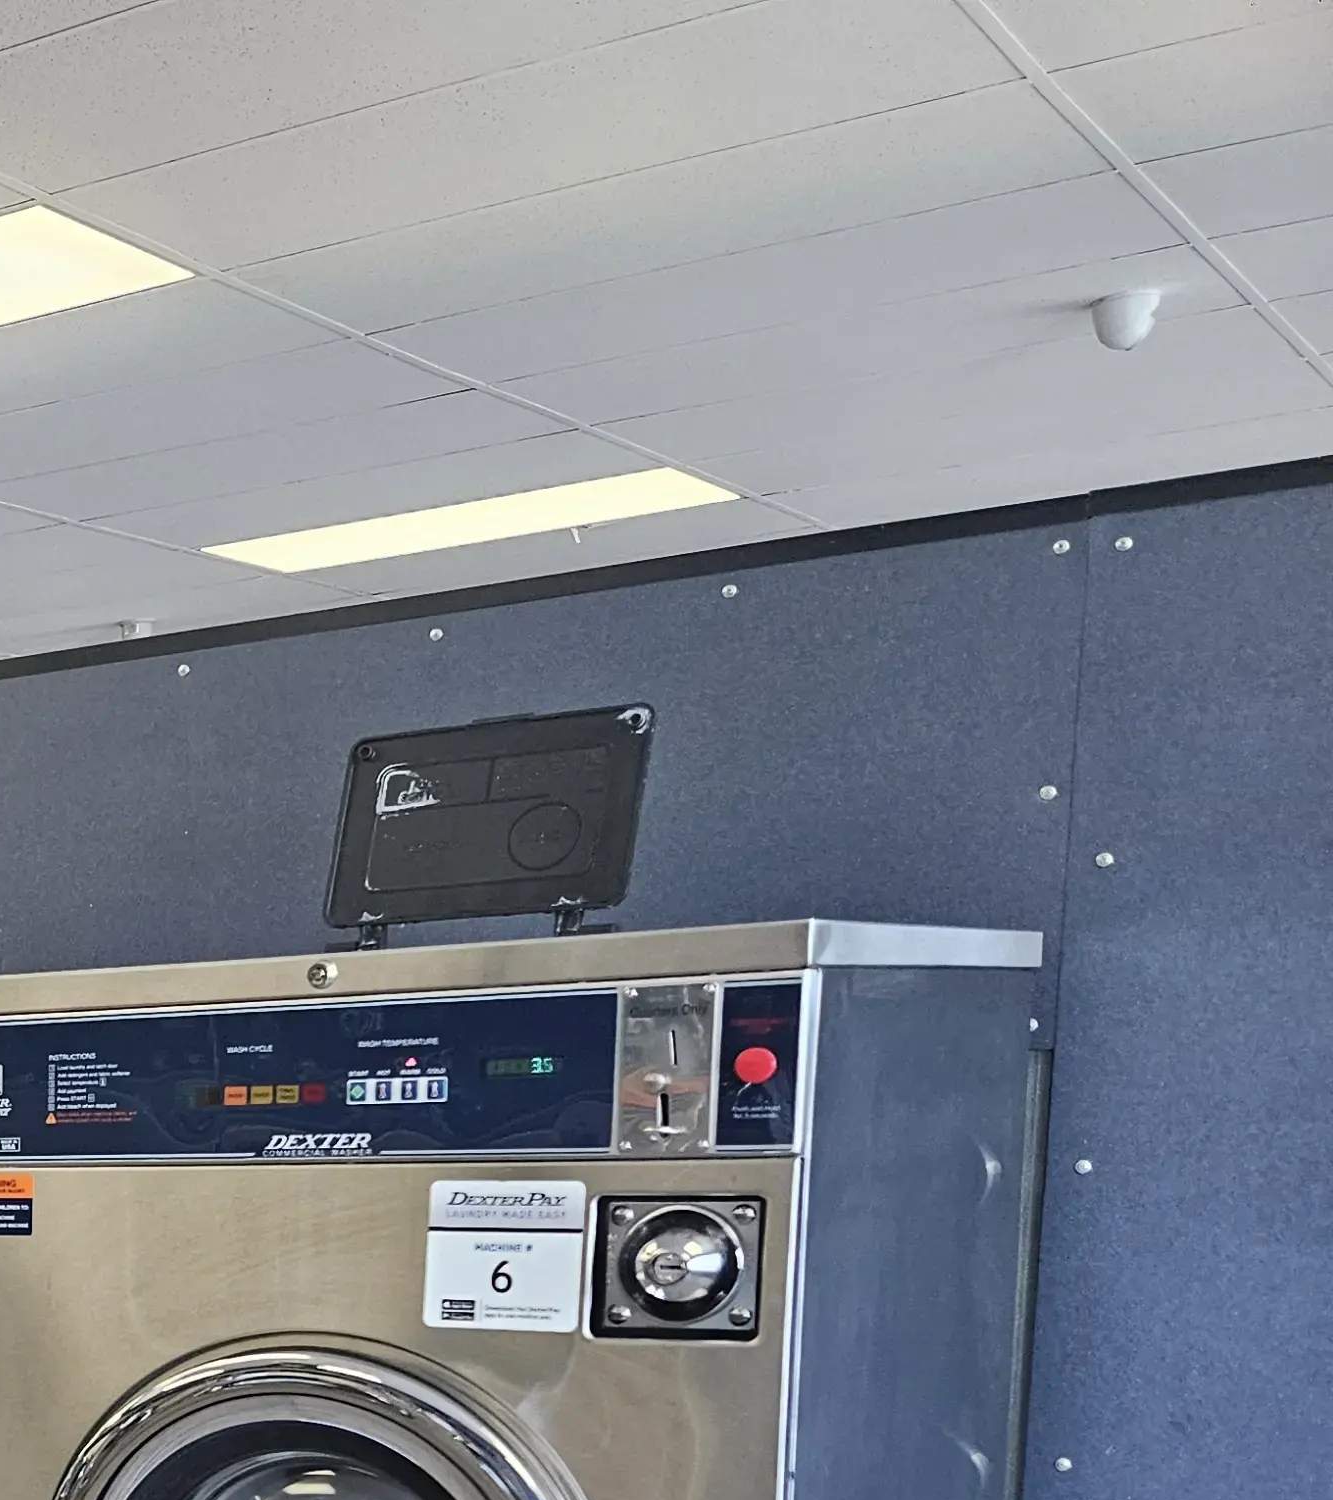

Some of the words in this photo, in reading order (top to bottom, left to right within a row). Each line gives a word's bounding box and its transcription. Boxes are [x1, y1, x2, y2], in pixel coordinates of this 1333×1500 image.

[382, 1038, 439, 1047] TEMPERATURE
[49, 1053, 96, 1061] INSTRUCTIONS
[264, 1133, 372, 1149] DEXTER
[331, 1148, 373, 1156] WASHER
[445, 1209, 498, 1219] LAUNDRY
[501, 1210, 535, 1219] MADE
[538, 1211, 567, 1219] EASY
[473, 1243, 523, 1253] MACHINE
[491, 1260, 513, 1293] 6
